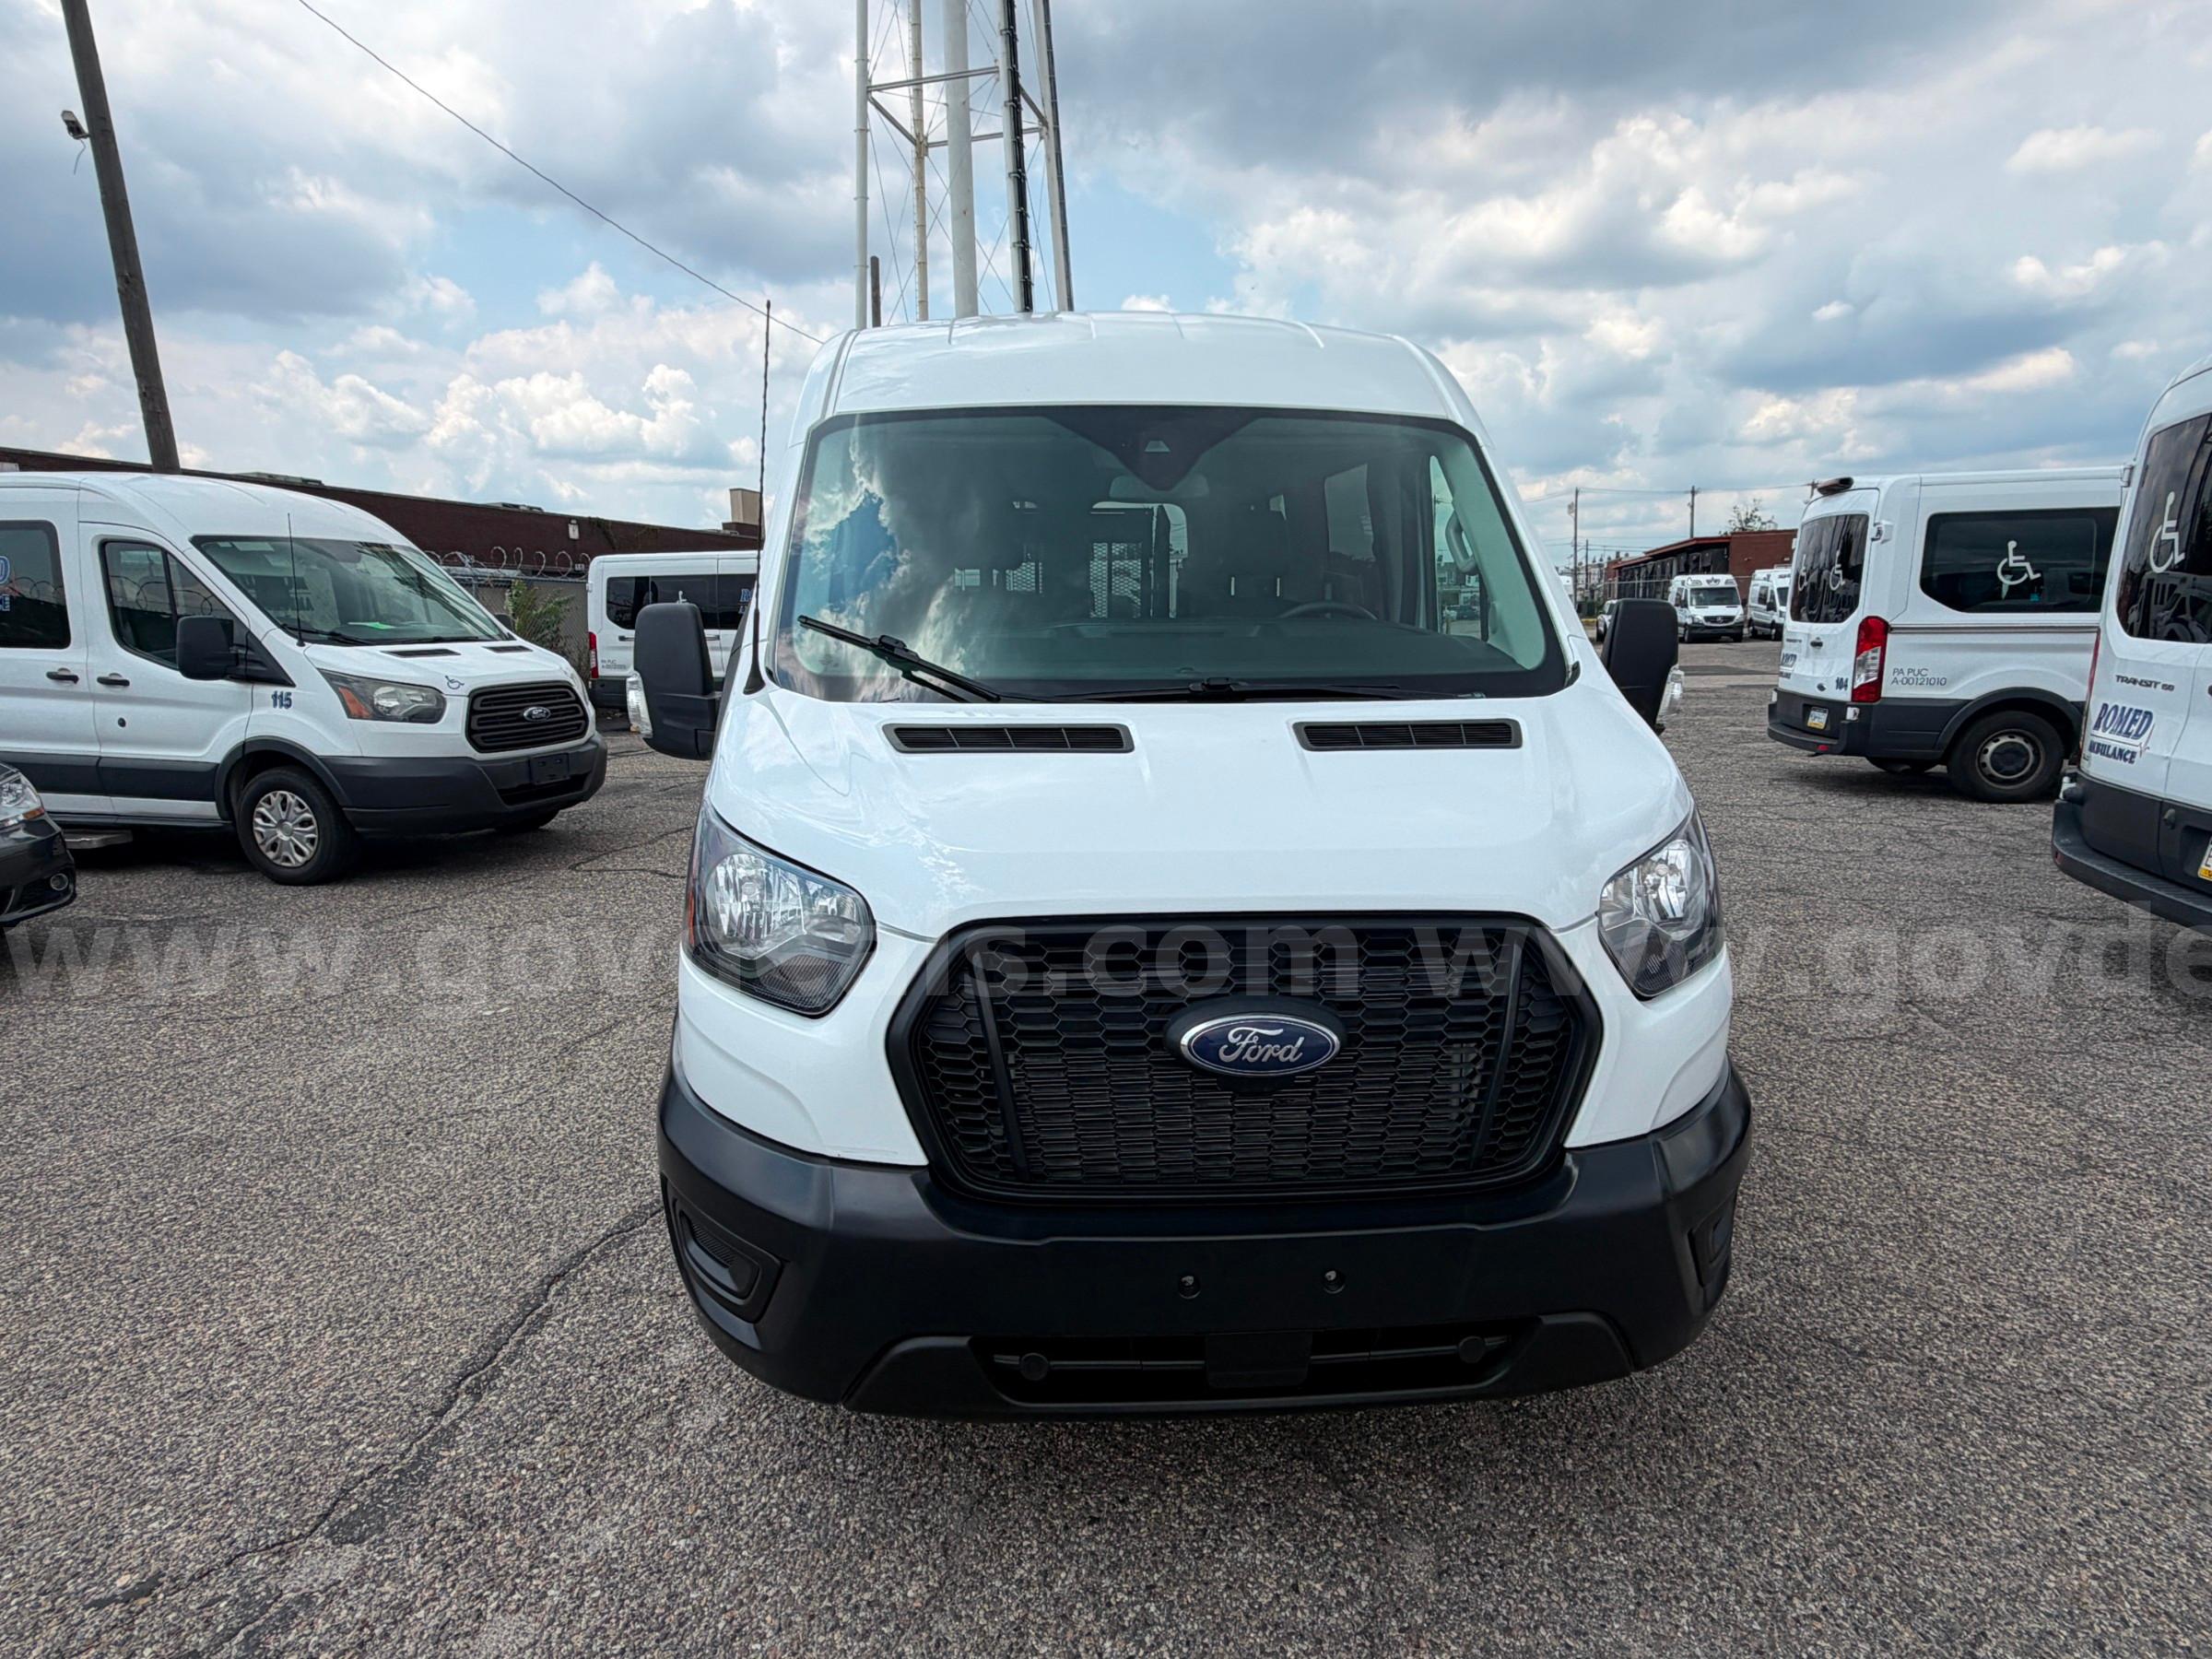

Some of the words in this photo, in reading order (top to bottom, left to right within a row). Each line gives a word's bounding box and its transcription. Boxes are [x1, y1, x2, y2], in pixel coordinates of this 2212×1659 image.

[1892, 667, 1905, 676] PA
[1907, 667, 1929, 677] PUC
[1890, 677, 1947, 687] A-00121010
[2115, 675, 2160, 688] TRANSIT
[271, 690, 292, 710] 115
[2092, 702, 2154, 740] ROMED
[1218, 1027, 1304, 1063] Ford
